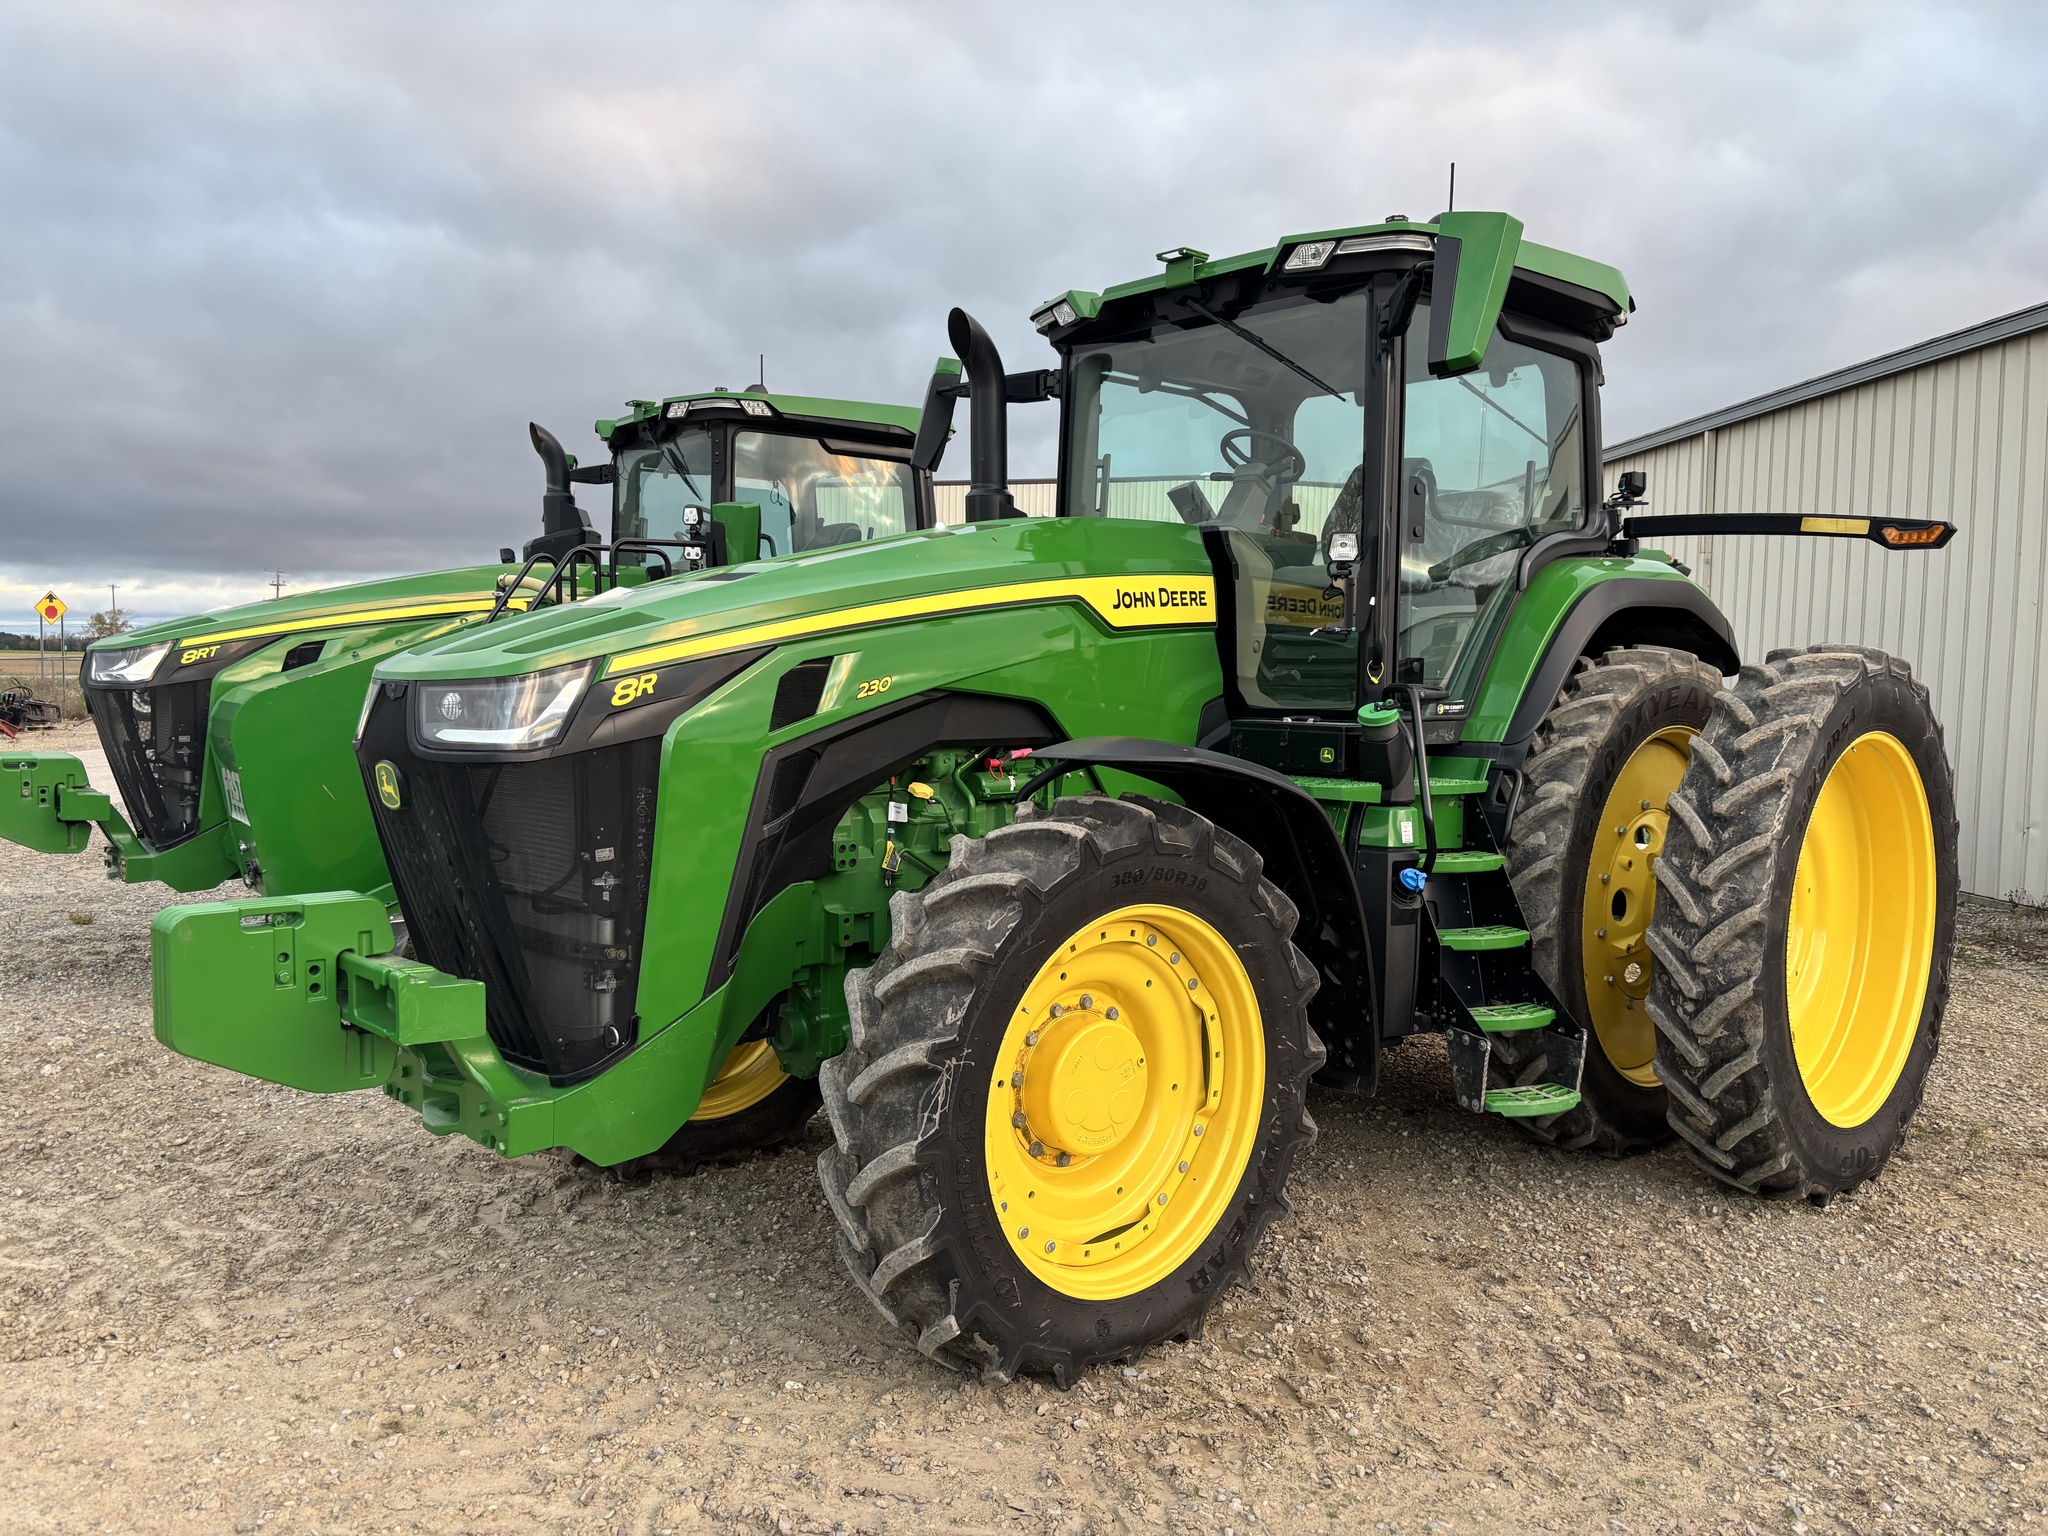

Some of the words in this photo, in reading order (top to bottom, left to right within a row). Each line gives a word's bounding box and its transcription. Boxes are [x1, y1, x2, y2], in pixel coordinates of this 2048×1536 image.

[1113, 588, 1156, 610] JOHN
[1158, 587, 1208, 608] DEERE
[180, 645, 222, 665] 8RT
[610, 673, 658, 707] 8R
[856, 675, 893, 700] 230
[1111, 865, 1209, 892] 380/80R38
